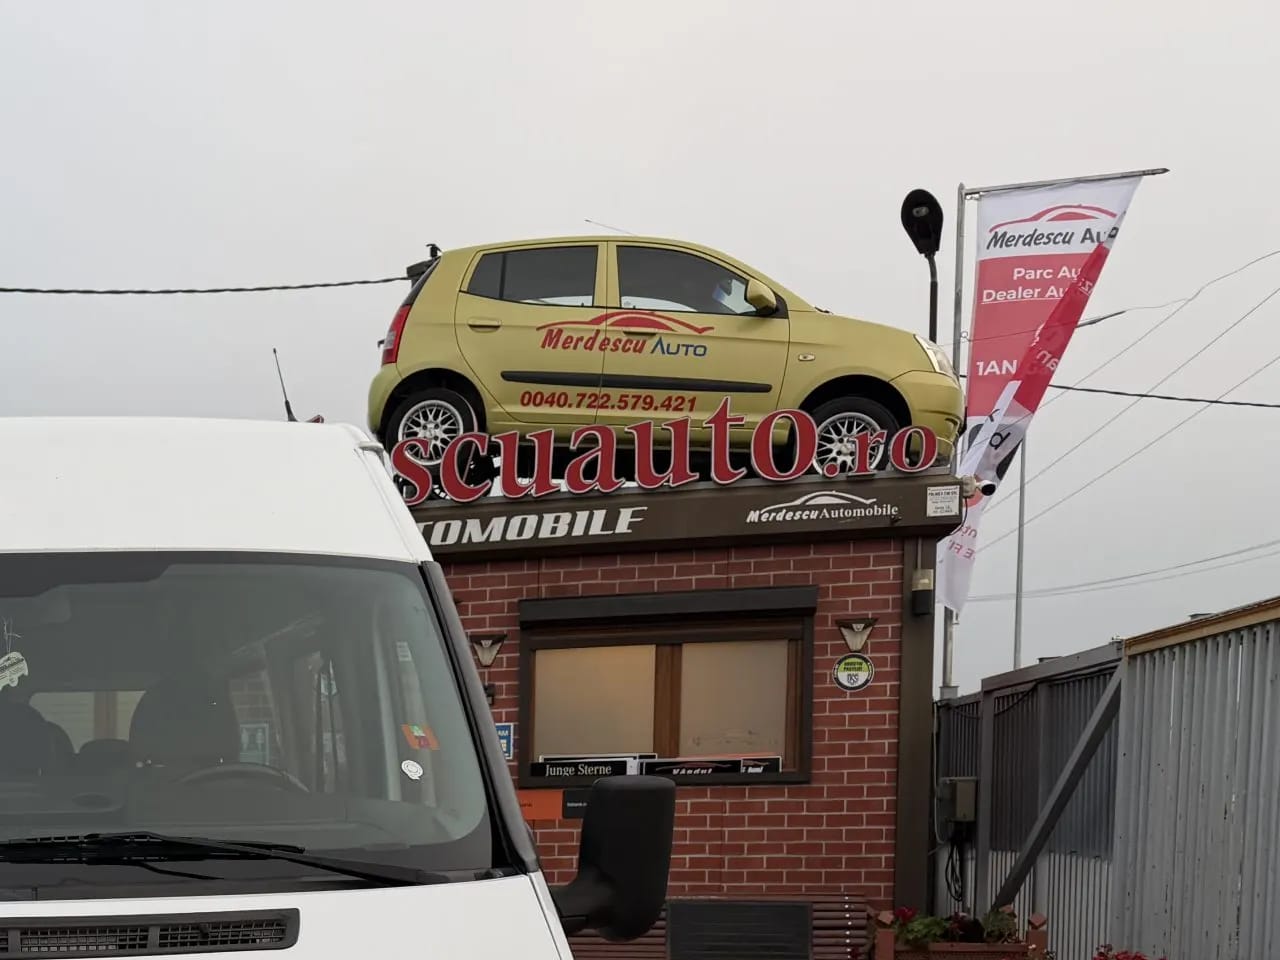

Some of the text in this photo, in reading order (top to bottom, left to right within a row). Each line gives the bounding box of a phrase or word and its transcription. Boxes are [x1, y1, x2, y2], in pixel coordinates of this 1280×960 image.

[986, 228, 1074, 250] Merdescu
[1013, 267, 1052, 281] Parc
[983, 286, 1041, 302] Dealer
[540, 328, 707, 358] Merdescu AUTO
[519, 391, 697, 412] 0040.722.579.421
[545, 763, 612, 777] Junge Sterne
